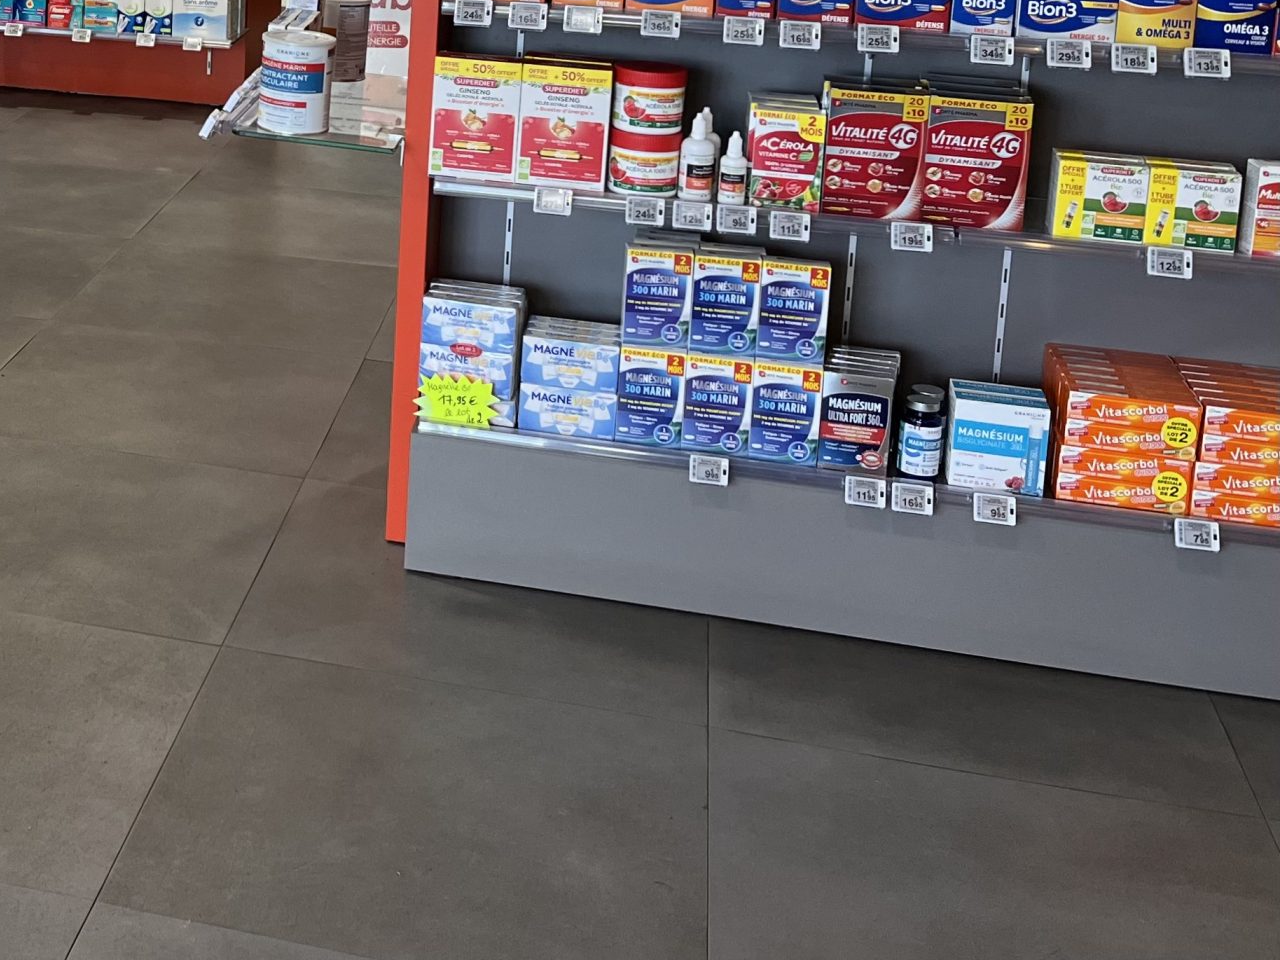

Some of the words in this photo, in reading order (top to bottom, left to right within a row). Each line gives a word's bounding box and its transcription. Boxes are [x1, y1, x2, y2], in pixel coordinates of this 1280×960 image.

[1161, 18, 1192, 30] MULTI
[1223, 21, 1260, 35] OMÉGA
[1261, 25, 1269, 36] 3
[1135, 27, 1143, 37] &
[1145, 26, 1182, 39] OMÉGA
[1183, 30, 1191, 40] 3
[472, 63, 496, 75] 50%
[456, 77, 495, 87] SUPERDIET
[459, 87, 492, 96] GINSENG
[840, 91, 877, 101] FORMAT
[878, 93, 896, 102] ÉCO
[909, 96, 924, 106] 20
[808, 115, 817, 127] 2
[800, 126, 823, 137] MOIS
[759, 138, 814, 152] ACÉROLA
[838, 147, 894, 159] DYNAMISANT
[1092, 174, 1126, 184] ACÉROLA
[1127, 177, 1142, 185] 500
[632, 285, 648, 294] 300
[650, 285, 678, 297] MARIN
[760, 386, 808, 403] MAGNÉSIUM
[828, 396, 882, 413] MAGNÉSIUM
[827, 410, 849, 424] ULTRA
[849, 412, 867, 425] FORT
[1095, 404, 1168, 419] Vitascorbol
[958, 426, 1024, 443] MAGNÉSIUM
[1178, 431, 1189, 444] 2
[1087, 458, 1158, 473] Vitascorbol
